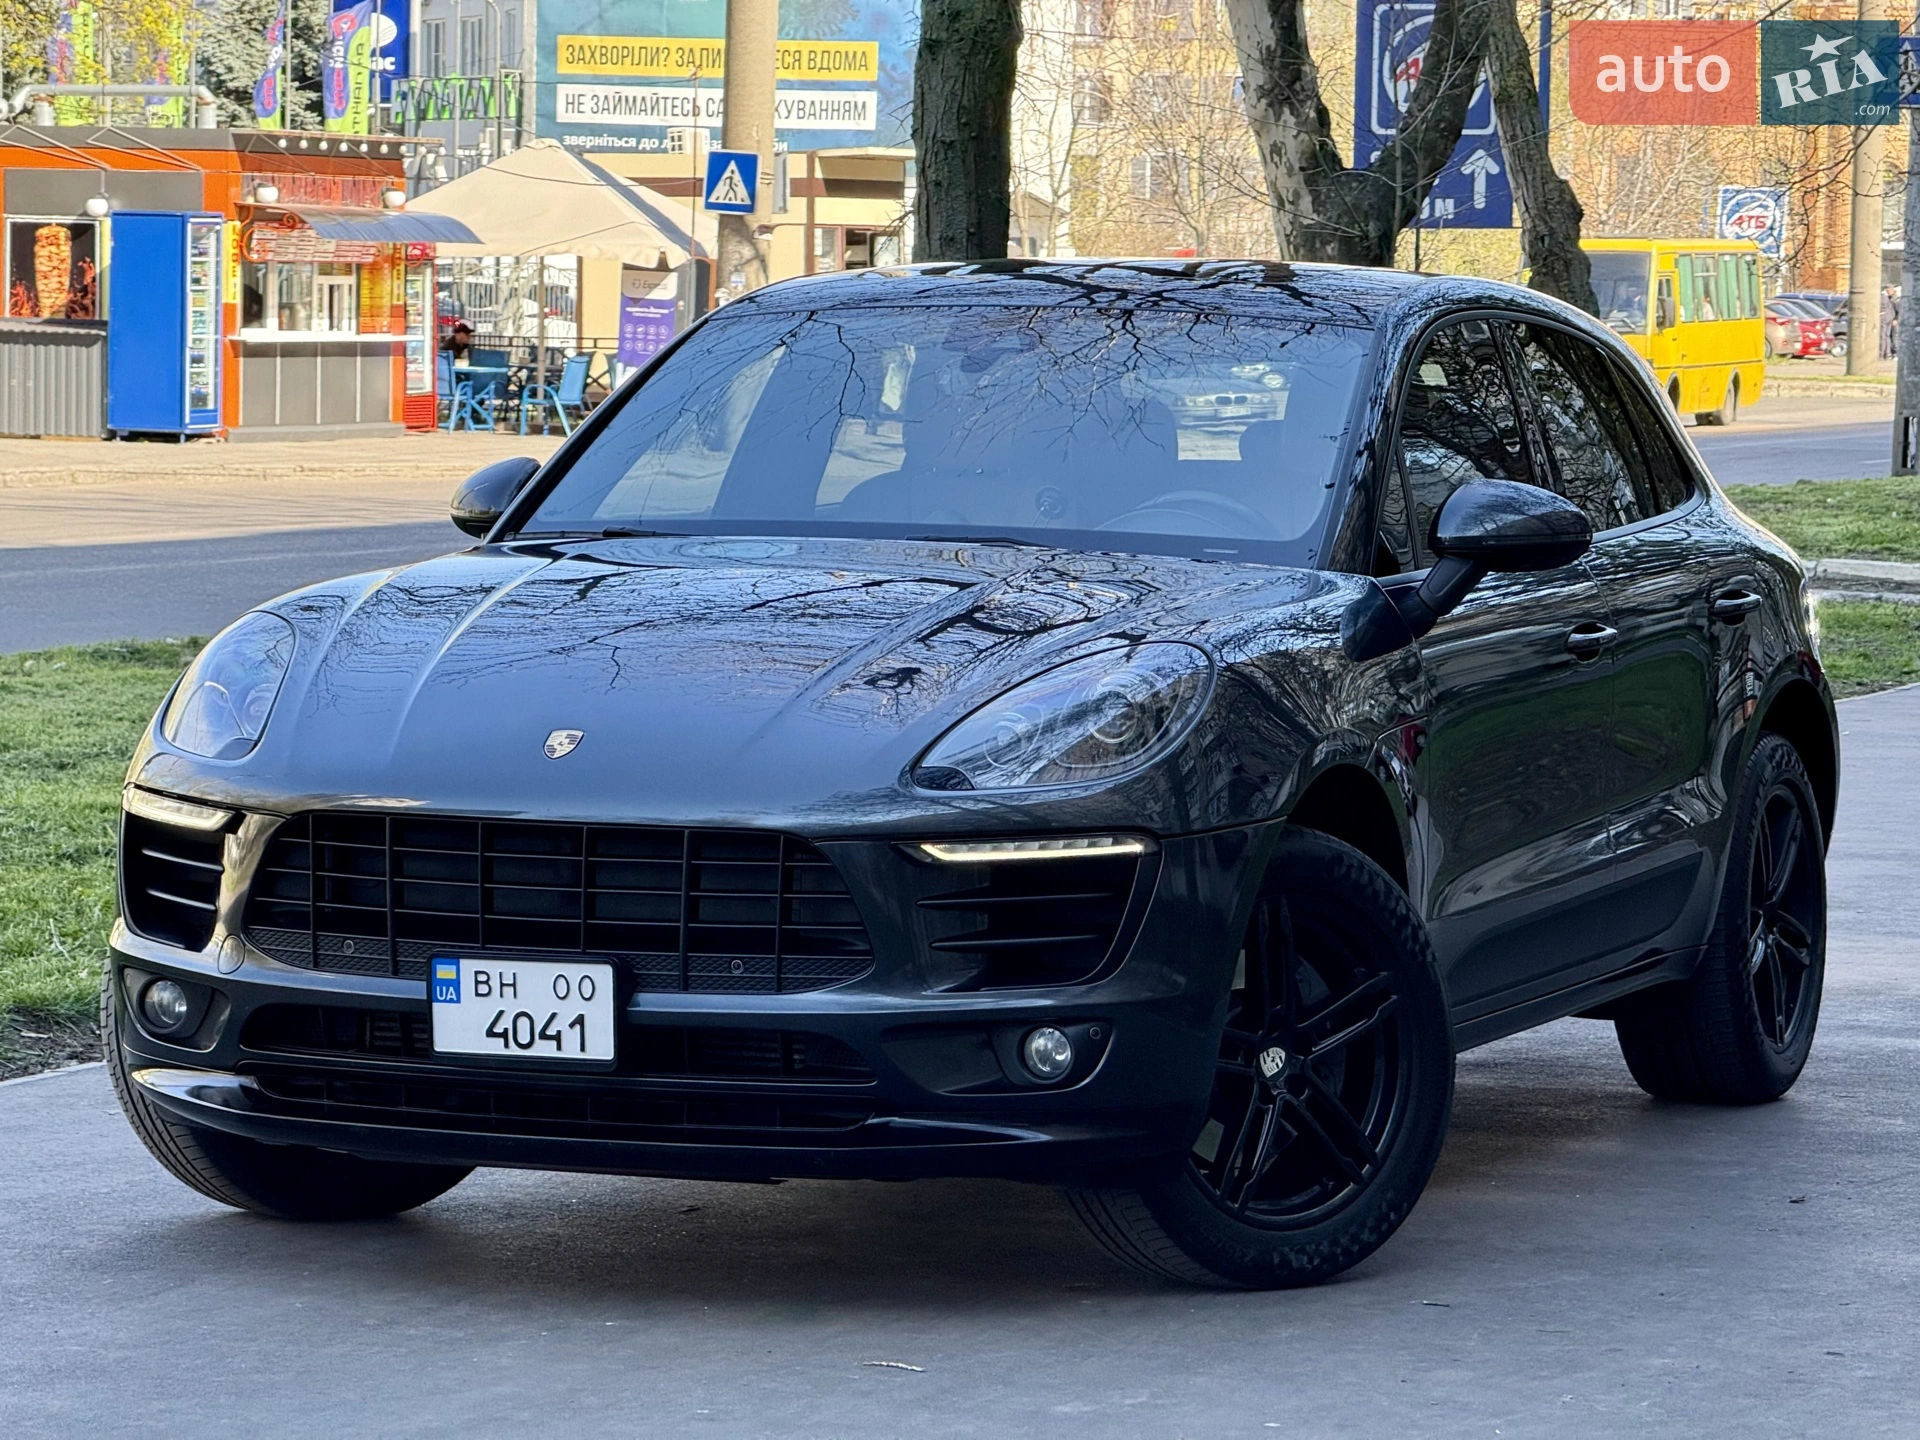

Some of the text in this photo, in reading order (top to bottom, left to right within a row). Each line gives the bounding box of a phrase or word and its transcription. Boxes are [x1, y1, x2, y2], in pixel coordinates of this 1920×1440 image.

[566, 44, 670, 67] ЗАХВОРІЛИ?
[807, 50, 868, 72] ВДОМА
[565, 93, 586, 114] НЕ
[590, 91, 701, 118] ЗАЙМАЙТЕСЬ
[562, 134, 636, 152] зверніться
[639, 140, 658, 151] до
[436, 986, 457, 1001] UA
[474, 970, 596, 1002] BH 00
[485, 1009, 586, 1053] 4041
